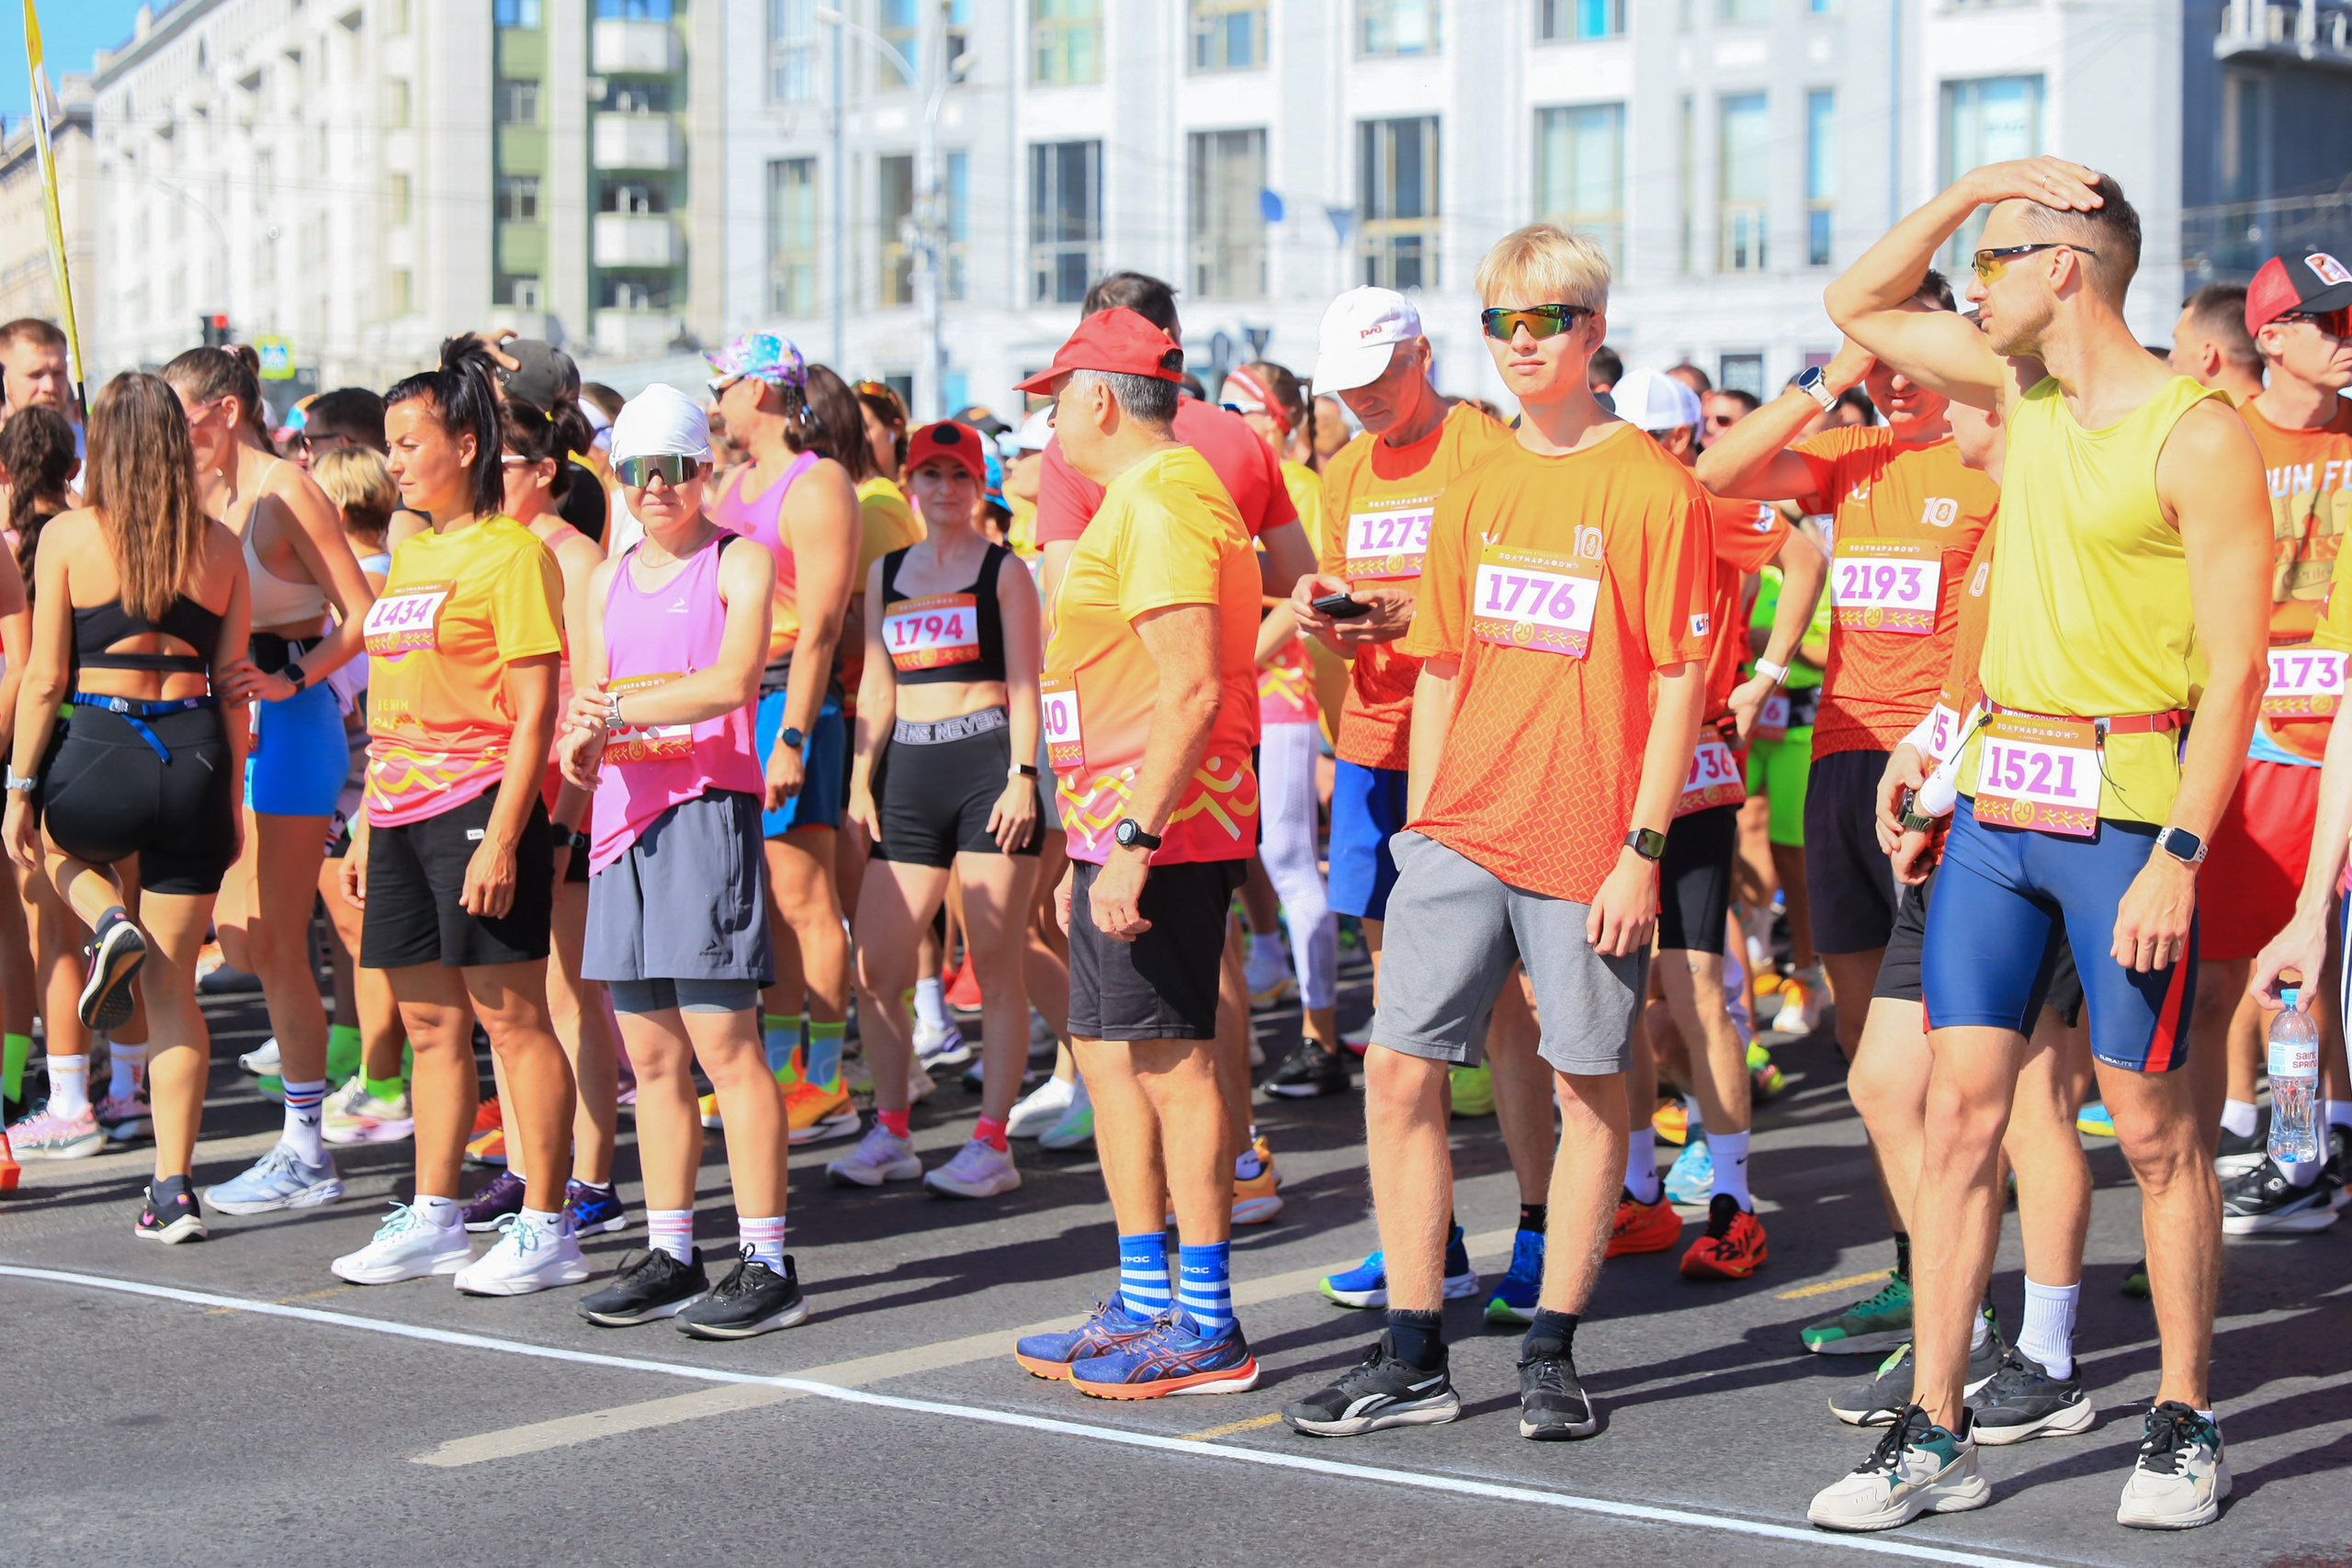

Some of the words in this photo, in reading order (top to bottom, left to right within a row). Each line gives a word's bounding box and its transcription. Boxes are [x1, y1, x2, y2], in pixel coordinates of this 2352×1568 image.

[1921, 497, 1958, 527] 10
[1360, 515, 1432, 549] 1273
[1574, 525, 1602, 560] 10
[1498, 553, 1572, 569] ПОЛУМАРАФОН
[1486, 573, 1575, 620] 1776
[1839, 565, 1922, 601] 2193
[371, 598, 434, 627] 1434
[894, 613, 964, 646] 1794
[1932, 709, 1949, 751] 5
[1996, 723, 2070, 739] ПОЛУМАРАФОН
[1988, 746, 2076, 797] 1521
